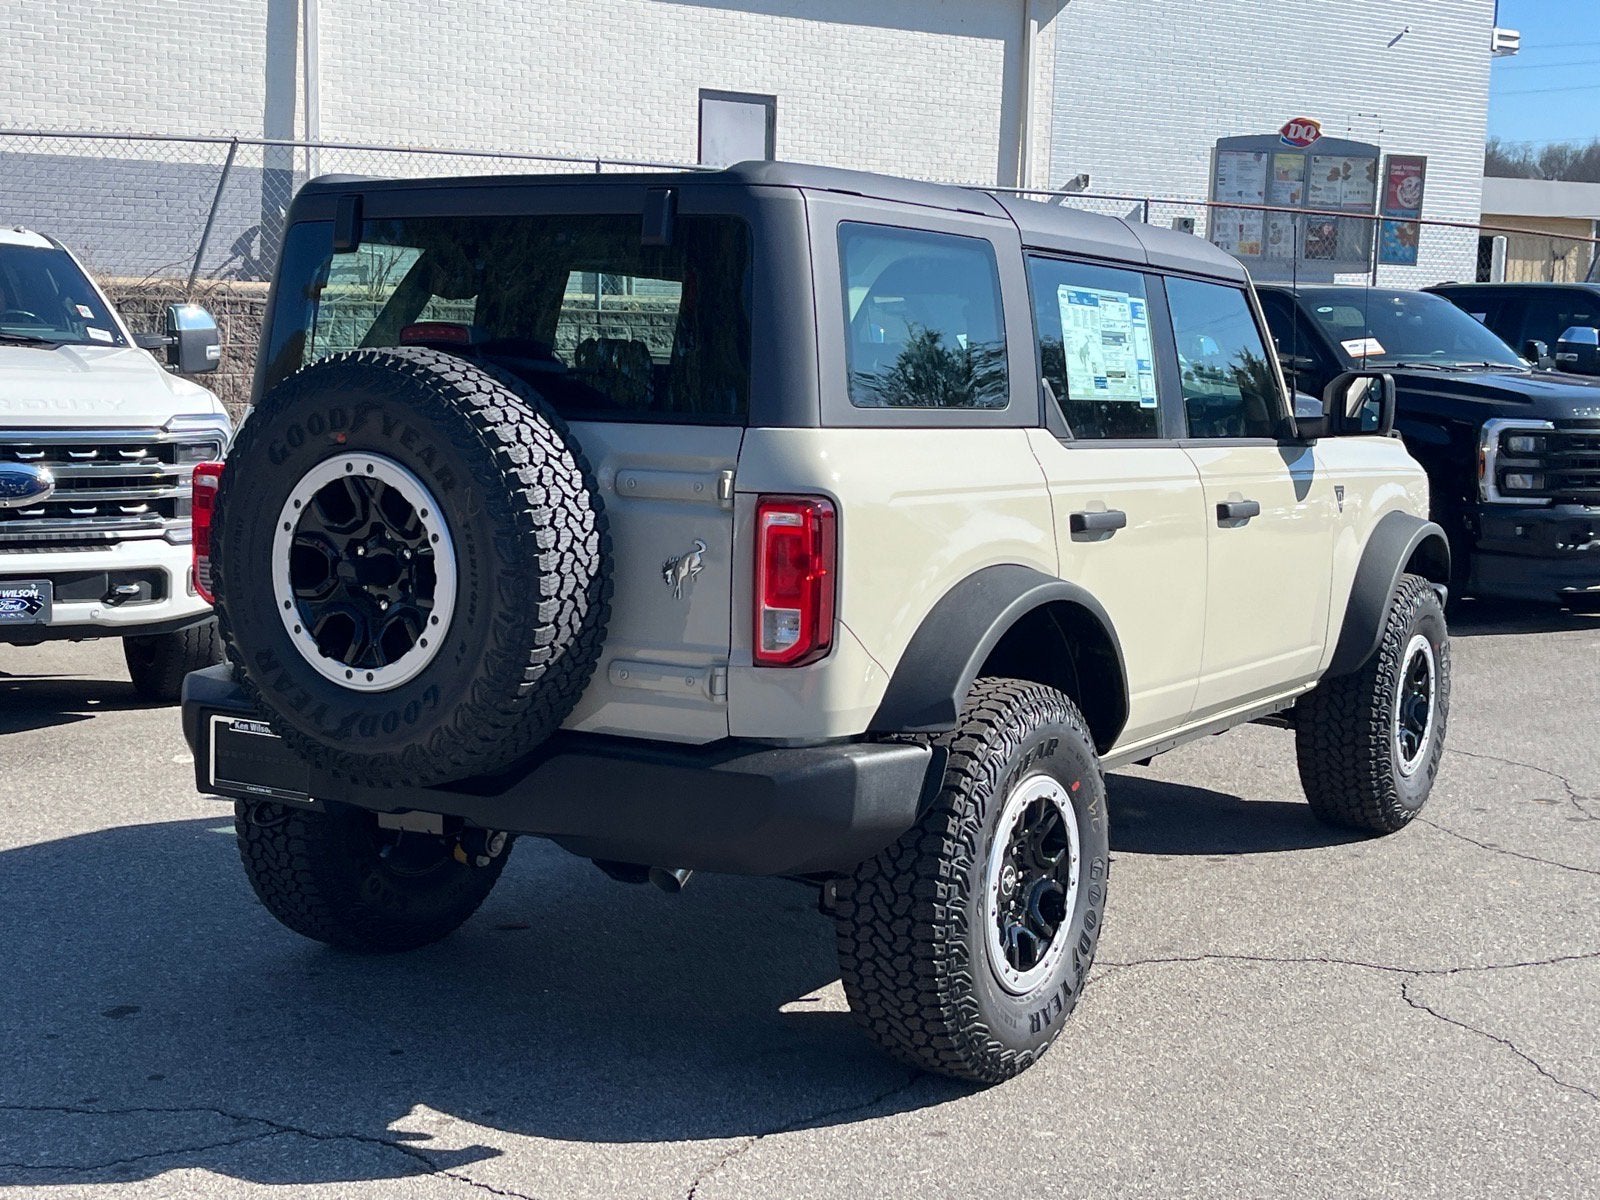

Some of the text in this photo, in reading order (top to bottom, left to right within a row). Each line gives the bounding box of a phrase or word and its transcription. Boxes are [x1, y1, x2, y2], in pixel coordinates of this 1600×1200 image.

[1287, 123, 1316, 142] DQ
[268, 401, 456, 491] GOODYEAR
[2, 589, 39, 599] WILSON
[255, 648, 440, 740] GOODYEAR
[234, 720, 249, 730] Ken
[1028, 856, 1106, 1034] GOODYEAR
